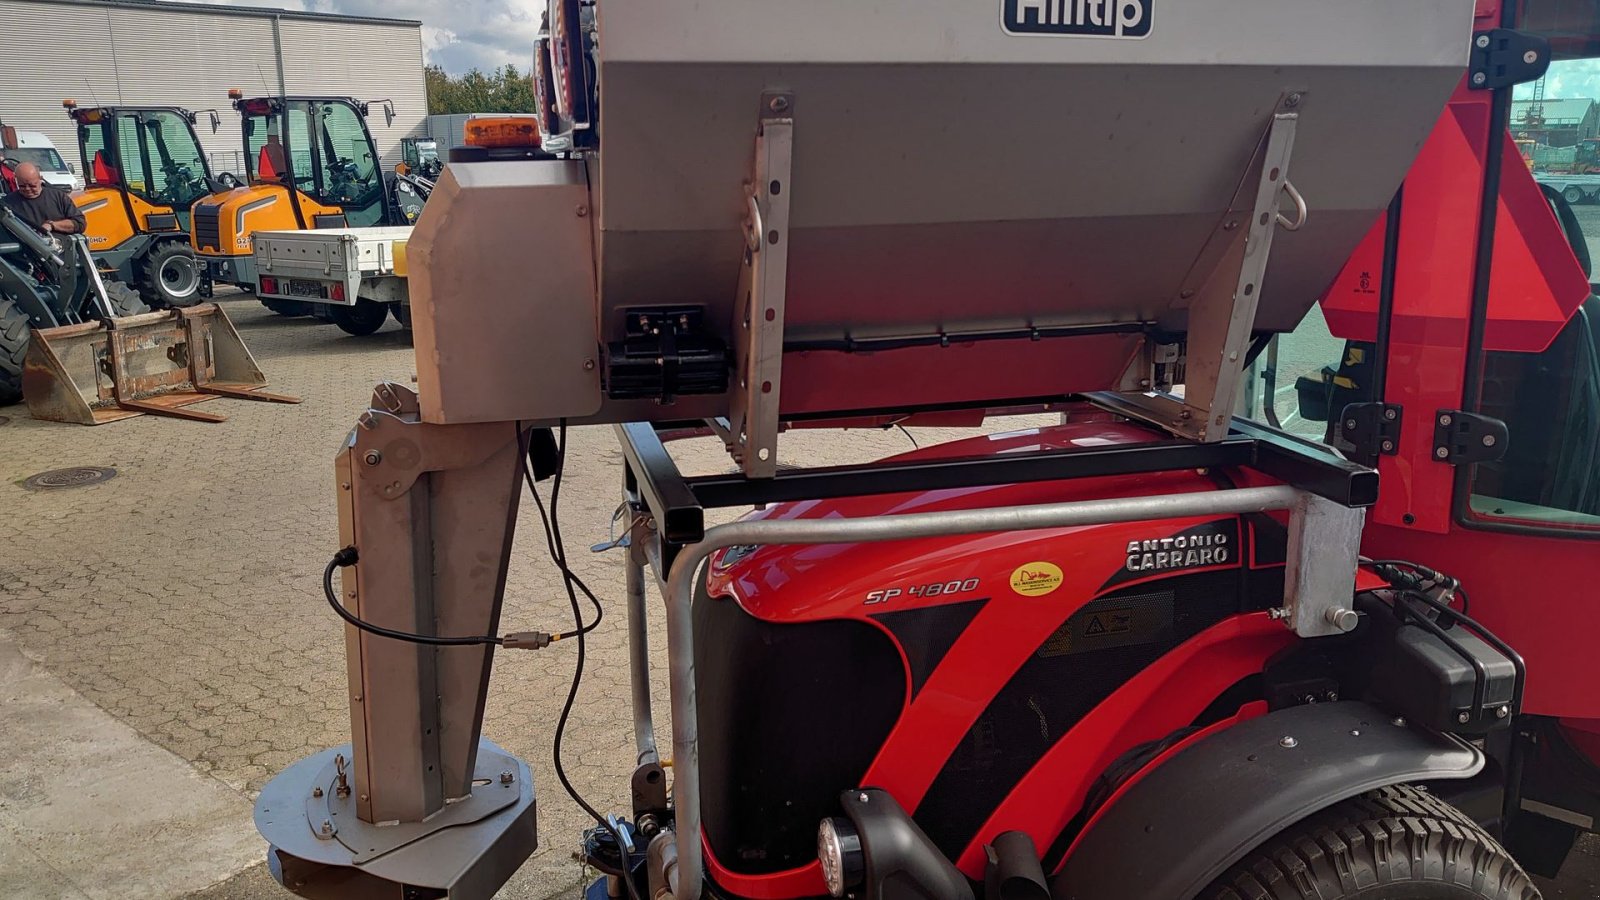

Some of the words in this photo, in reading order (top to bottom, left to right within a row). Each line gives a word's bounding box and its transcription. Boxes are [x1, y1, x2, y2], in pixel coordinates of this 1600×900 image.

[1126, 534, 1227, 553] ANTONIO
[1126, 547, 1228, 572] CARRARO
[864, 589, 902, 605] SP
[908, 578, 980, 597] 4800
